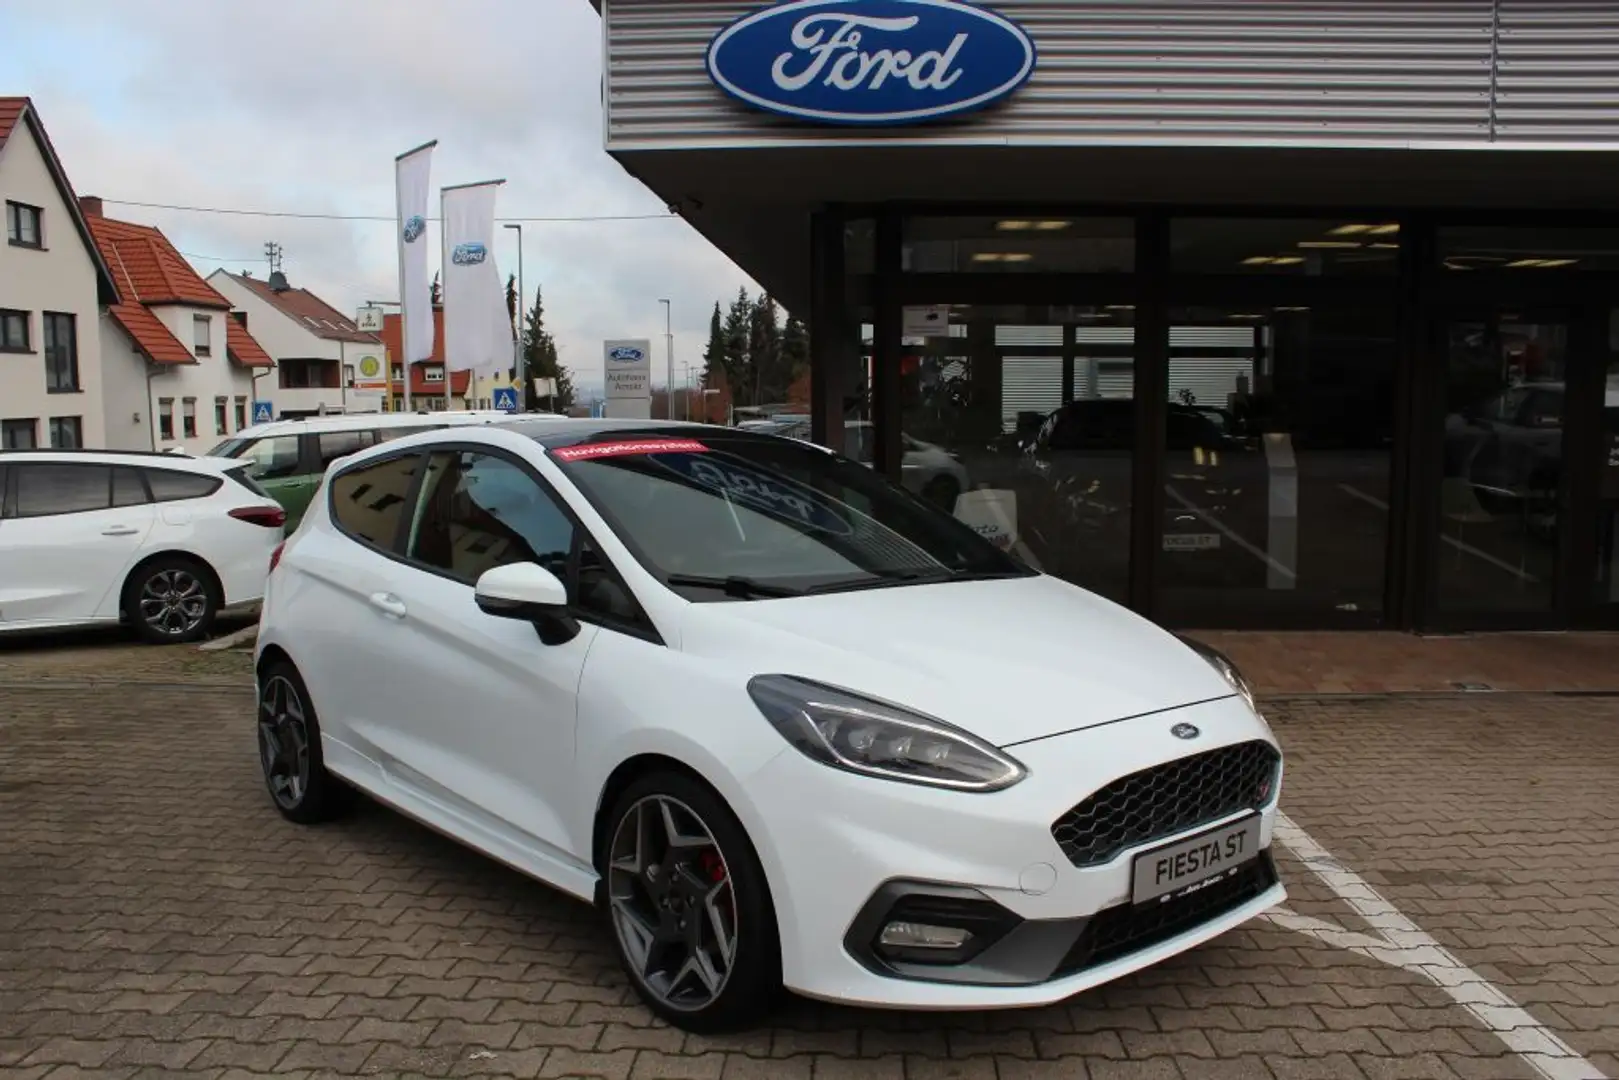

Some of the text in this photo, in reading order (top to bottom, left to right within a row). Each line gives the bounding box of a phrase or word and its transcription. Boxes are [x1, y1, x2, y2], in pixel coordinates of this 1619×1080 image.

[770, 12, 969, 91] Ford
[453, 246, 485, 264] Ford
[1155, 829, 1247, 885] FIESTA ST
